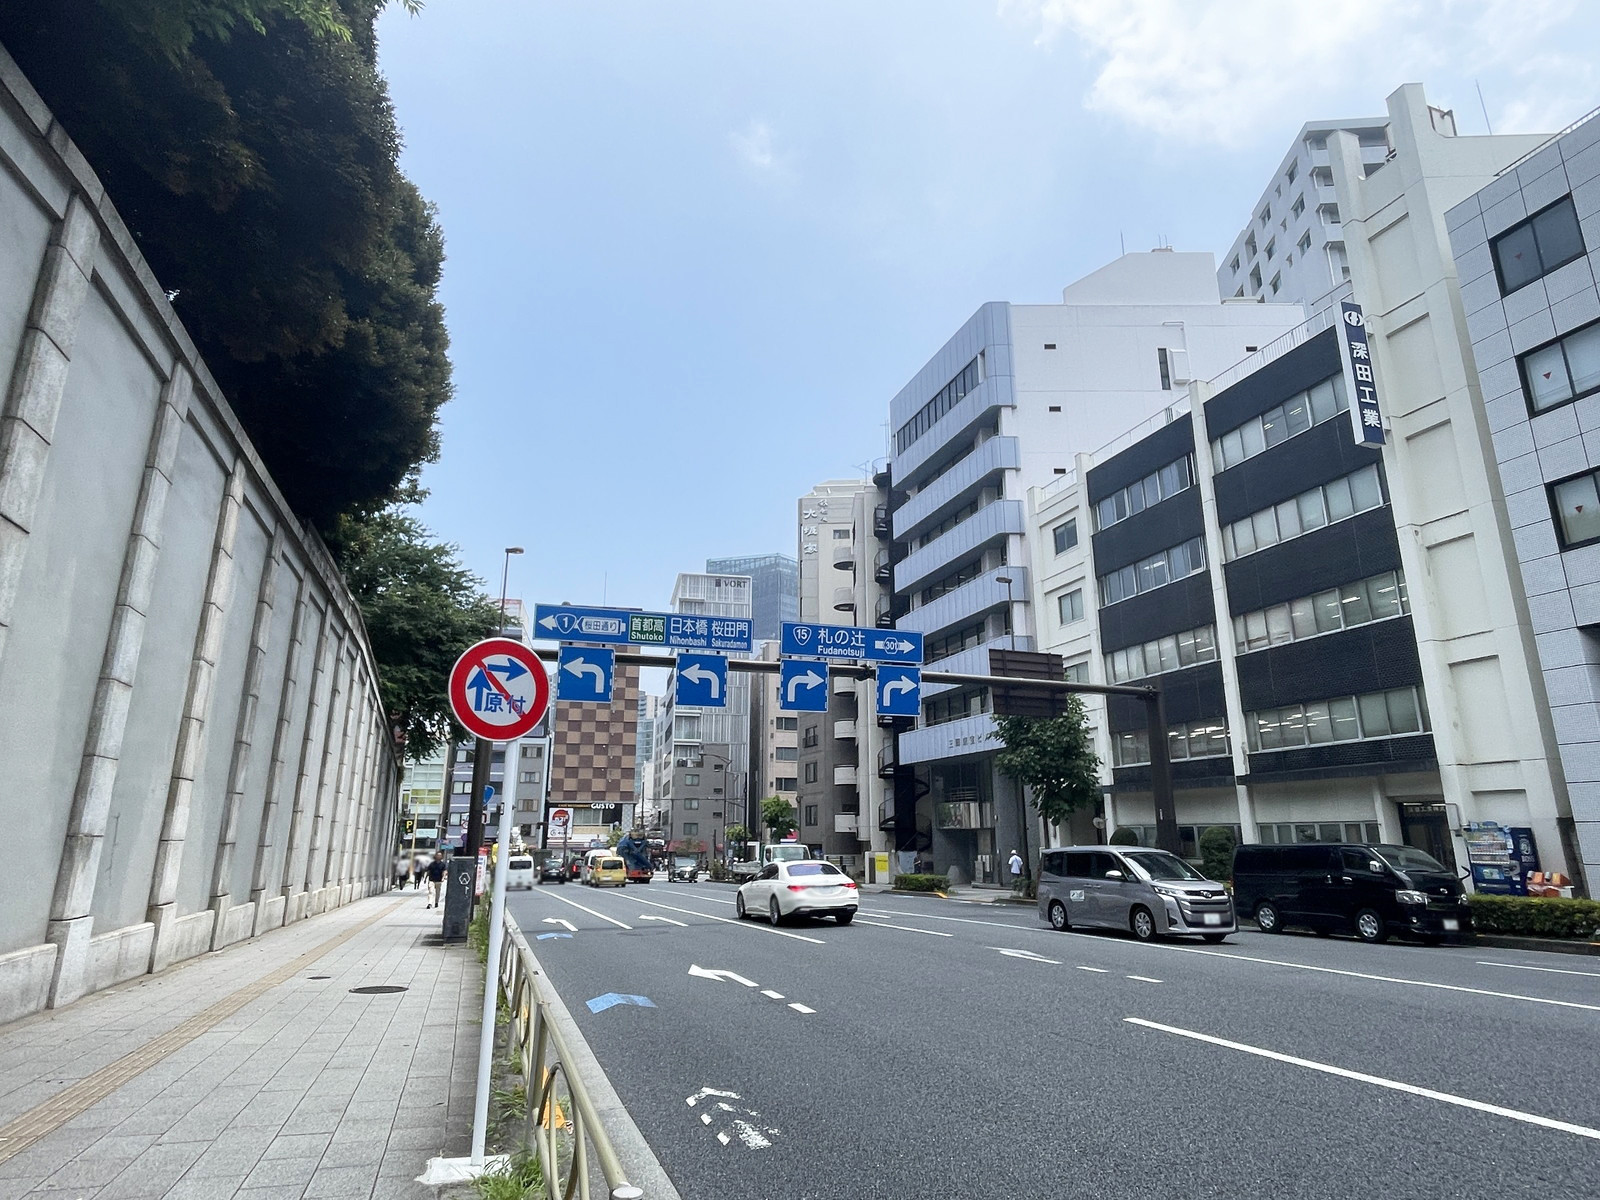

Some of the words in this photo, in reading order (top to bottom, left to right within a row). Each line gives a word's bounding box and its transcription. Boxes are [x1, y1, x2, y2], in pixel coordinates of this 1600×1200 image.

[1351, 341, 1381, 428] 深田工業
[563, 616, 568, 628] 1
[584, 620, 617, 632] 桜田通り
[631, 617, 664, 633] 首都高
[670, 617, 708, 636] 日本橋
[711, 620, 748, 638] 桜田門
[631, 631, 663, 641] Shutoko
[796, 628, 808, 640] 15
[817, 628, 866, 647] 札の辻
[669, 635, 707, 647] Nihonbashi
[711, 639, 748, 649] Sakuradamon
[885, 641, 898, 650] 301
[817, 645, 865, 657] Fudanotsuji
[484, 692, 526, 716] 原付
[406, 820, 413, 829] P
